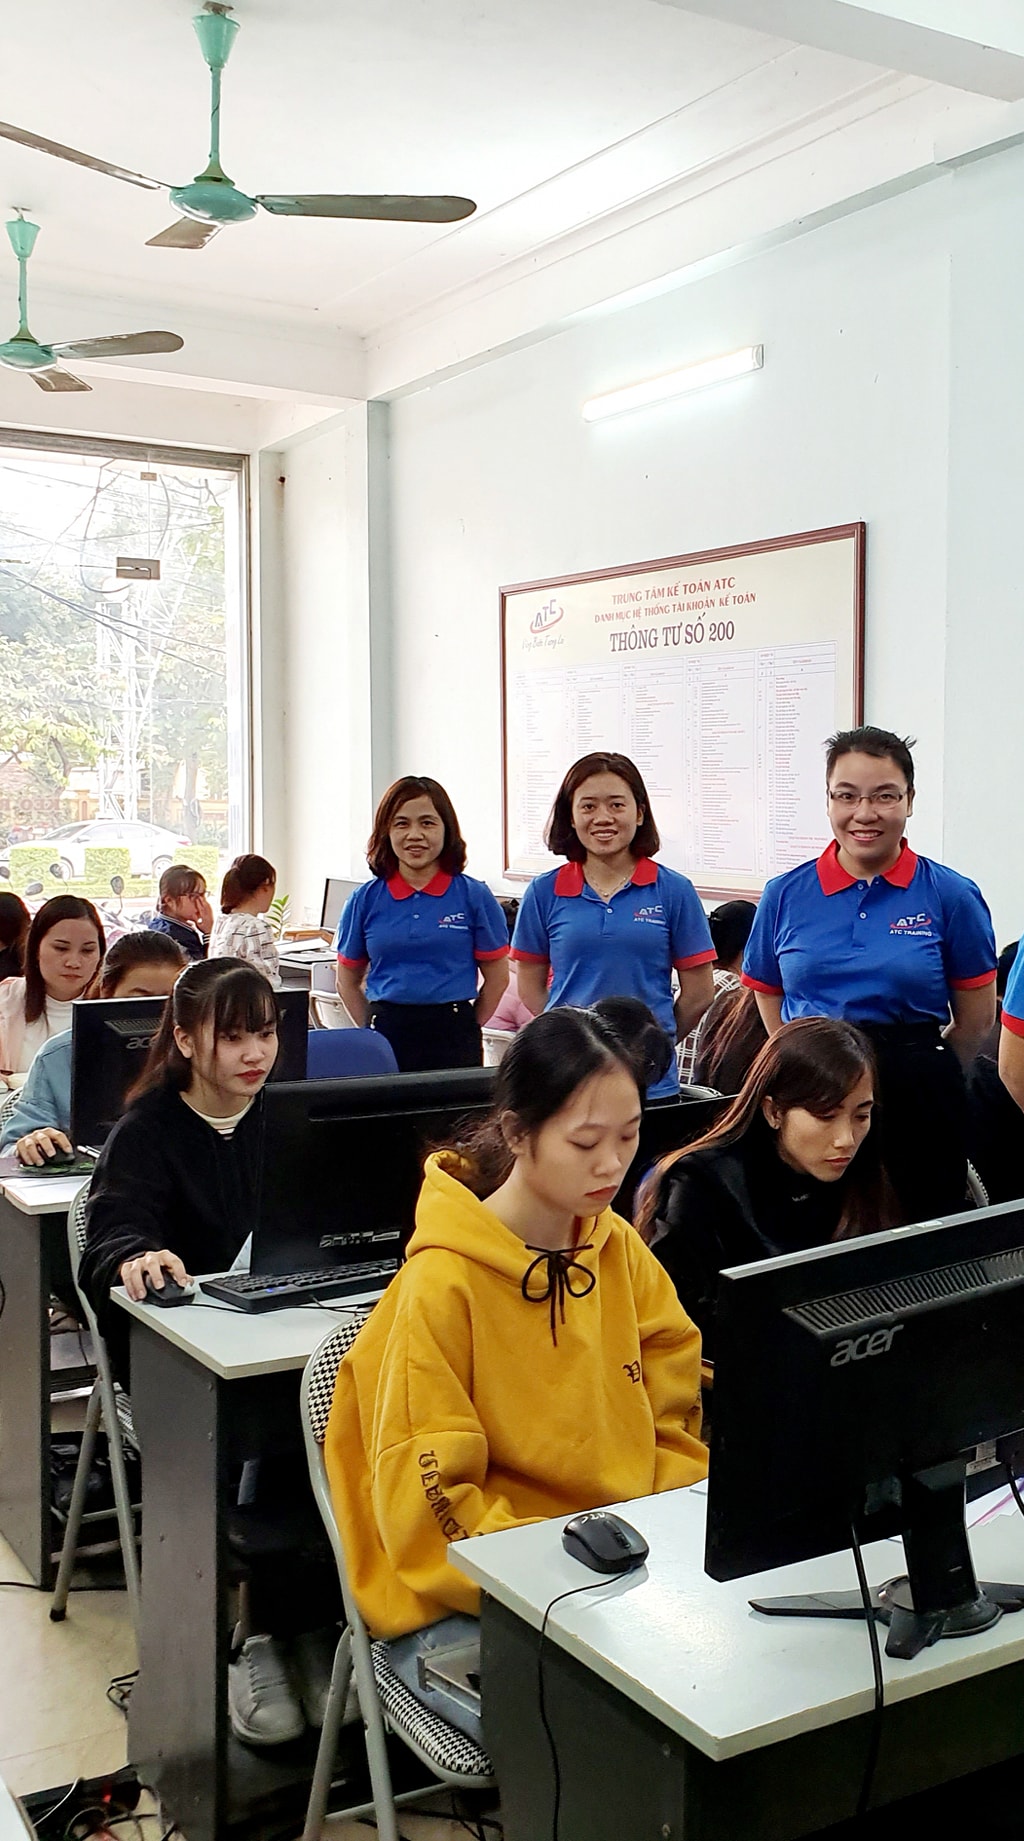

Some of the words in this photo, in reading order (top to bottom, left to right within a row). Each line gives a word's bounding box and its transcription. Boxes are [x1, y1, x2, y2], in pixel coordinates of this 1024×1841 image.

[612, 591, 642, 605] TRUNG
[645, 586, 665, 600] TÂM
[667, 581, 680, 597] KẾ
[683, 579, 711, 595] TOÁN
[713, 576, 736, 590] ATC
[534, 599, 557, 628] ATC
[594, 611, 615, 624] DANH
[615, 610, 631, 622] MỤC
[632, 607, 642, 621] HỆ
[645, 602, 671, 617] THỐNG
[672, 601, 685, 614] TÀI
[719, 593, 731, 607] KẾ
[732, 592, 757, 605] TOÁN
[610, 624, 659, 652] THÔNG
[662, 621, 683, 647] TƯ
[684, 612, 706, 645] SỐ
[708, 620, 735, 642] 200
[443, 912, 465, 923] ATC
[639, 904, 663, 915] ATC
[897, 913, 926, 927] ATC
[830, 1324, 904, 1367] acer
